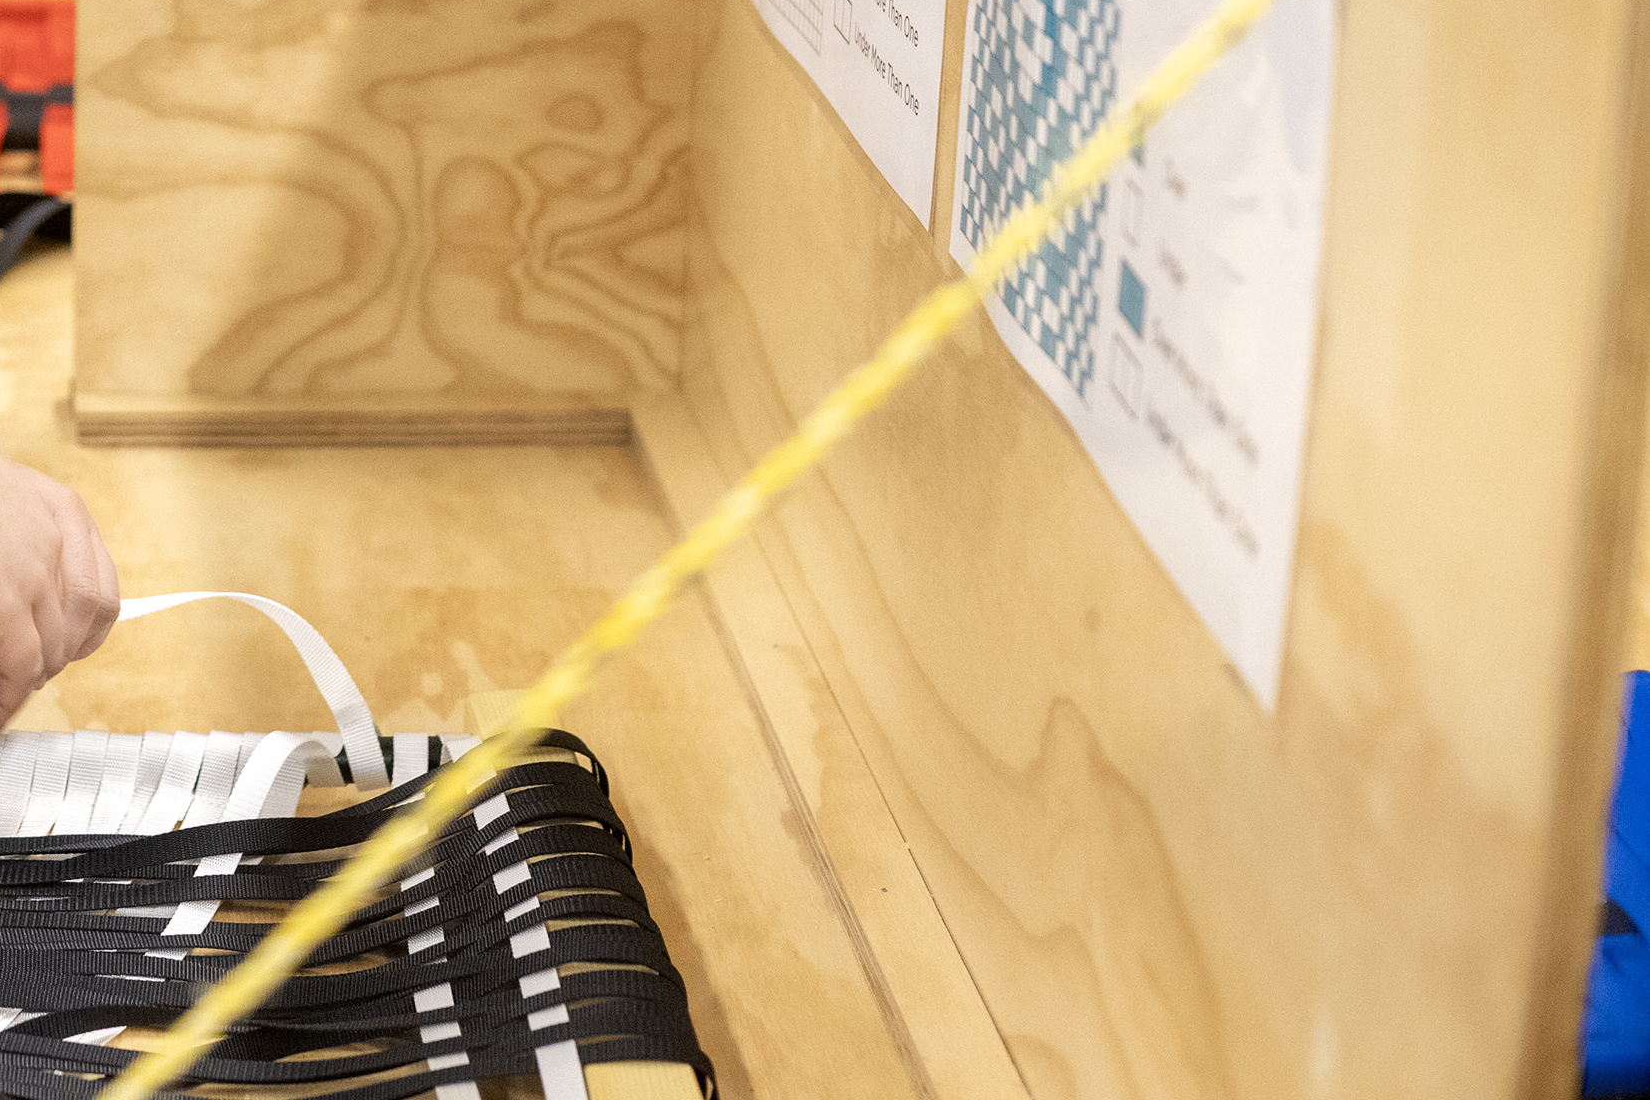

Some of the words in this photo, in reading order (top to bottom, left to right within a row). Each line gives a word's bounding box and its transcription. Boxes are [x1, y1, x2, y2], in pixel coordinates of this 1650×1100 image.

[904, 15, 919, 47] One
[854, 21, 870, 58] Under
[871, 44, 886, 79] More
[887, 63, 902, 99] Than
[904, 83, 919, 116] One
